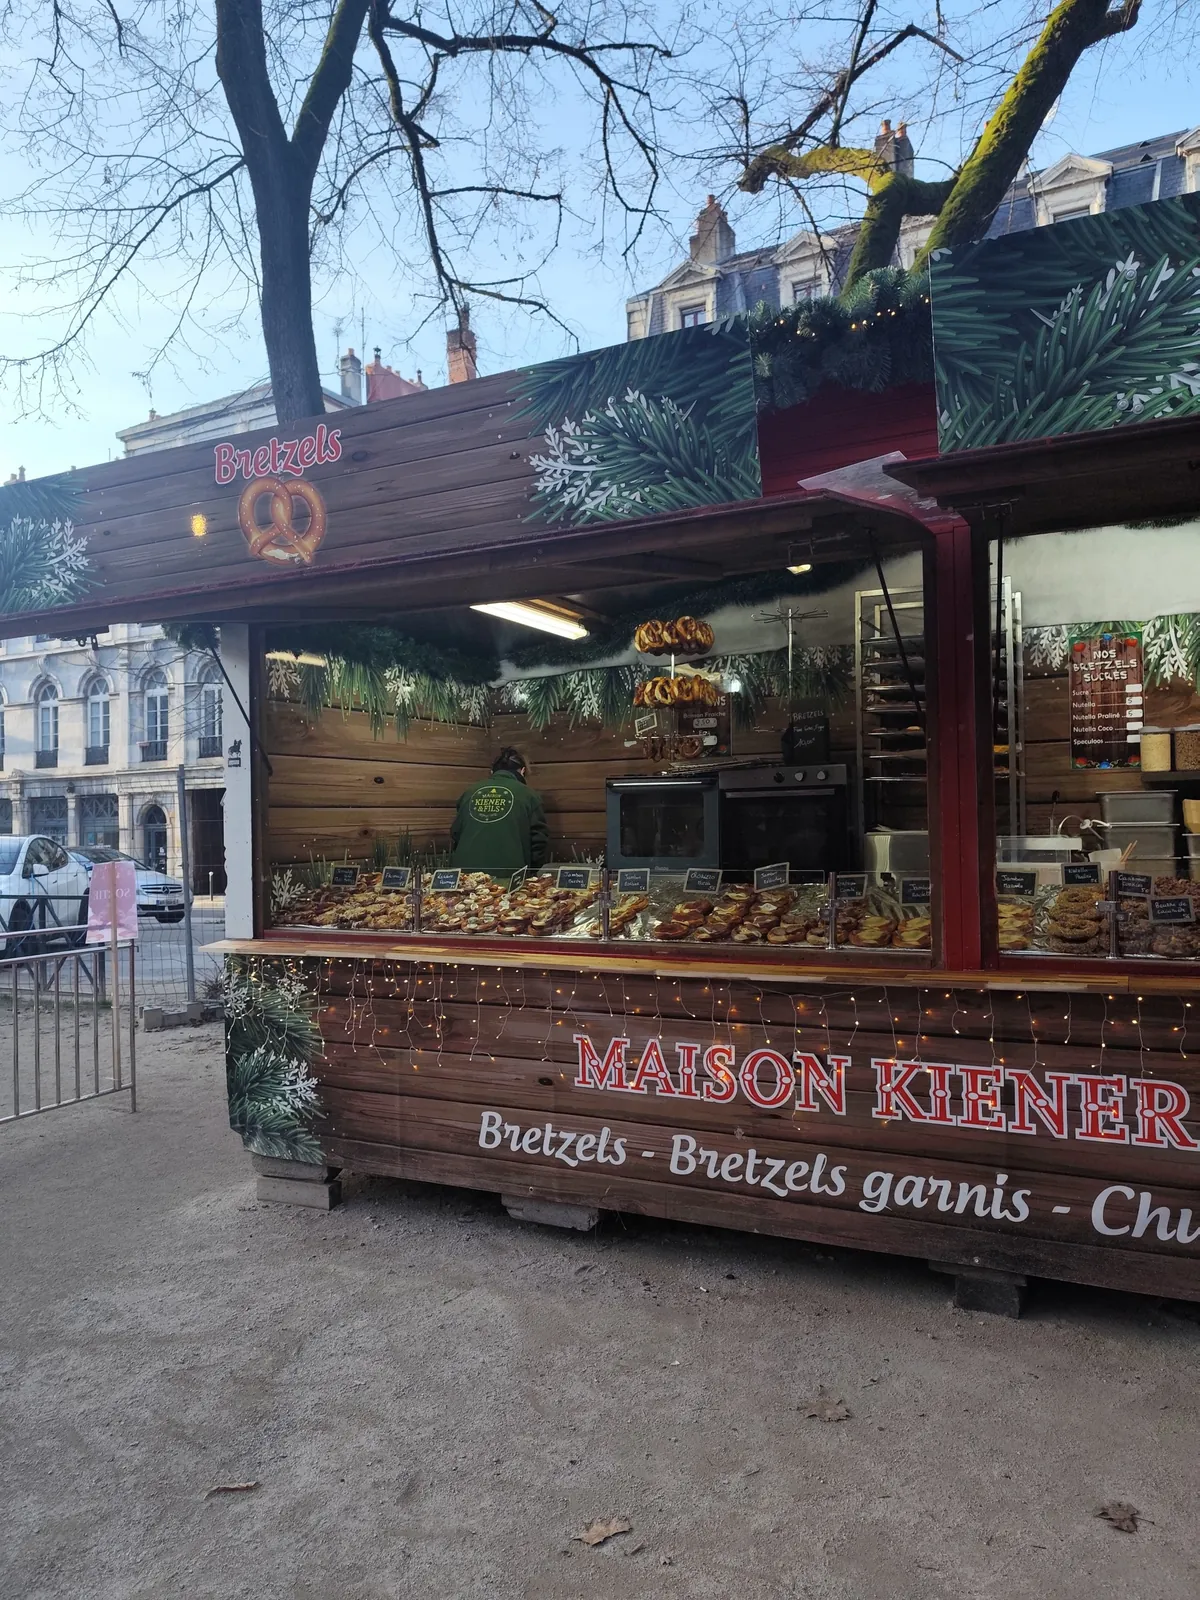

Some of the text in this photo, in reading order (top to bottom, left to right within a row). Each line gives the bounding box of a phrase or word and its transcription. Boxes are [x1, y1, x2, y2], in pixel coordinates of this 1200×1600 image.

[214, 424, 342, 484] Bretzels
[1073, 658, 1138, 672] BRETZELS
[1093, 649, 1117, 659] NOS
[793, 710, 824, 722] BRETZELS
[573, 1033, 1200, 1152] MAISON KIENER
[478, 1110, 628, 1167] Bretzels
[668, 1134, 848, 1197] Bretzels
[858, 1171, 1032, 1223] garnis
